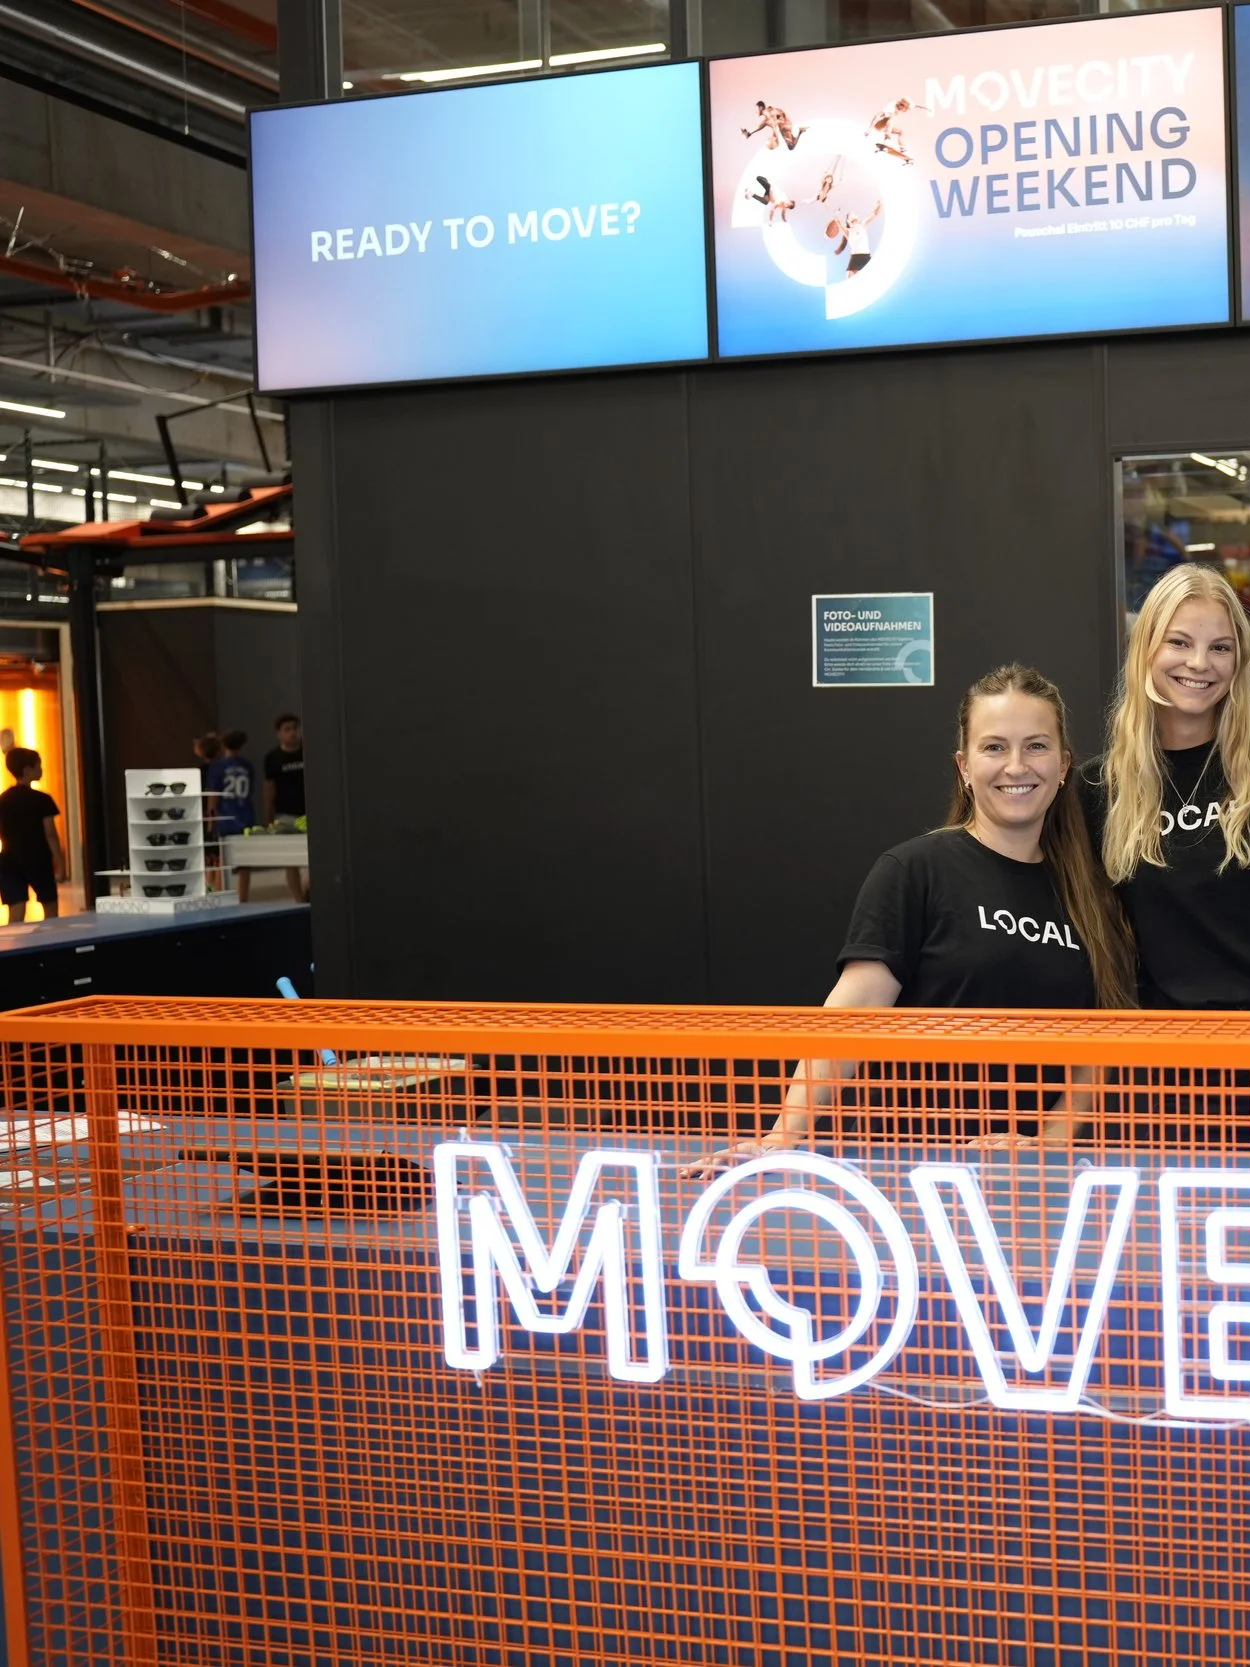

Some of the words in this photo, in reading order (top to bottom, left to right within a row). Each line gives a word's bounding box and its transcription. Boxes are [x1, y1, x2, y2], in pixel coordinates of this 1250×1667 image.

[925, 52, 1195, 118] MOVECITY
[935, 106, 1190, 169] OPENING
[930, 158, 1197, 219] WEEKEND
[311, 221, 432, 262] READY
[443, 215, 495, 251] TO
[508, 200, 641, 245] MOVE?
[1109, 219, 1123, 231] 10
[1125, 216, 1150, 230] CHF
[1151, 218, 1172, 229] pro
[1173, 214, 1197, 227] Tag
[823, 611, 856, 621] FOTO-
[857, 610, 882, 620] UND
[823, 621, 922, 632] VIDEOAUFNAHMEN
[223, 775, 249, 799] 20
[1159, 800, 1234, 836] OCA
[978, 905, 1080, 951] LOCAL
